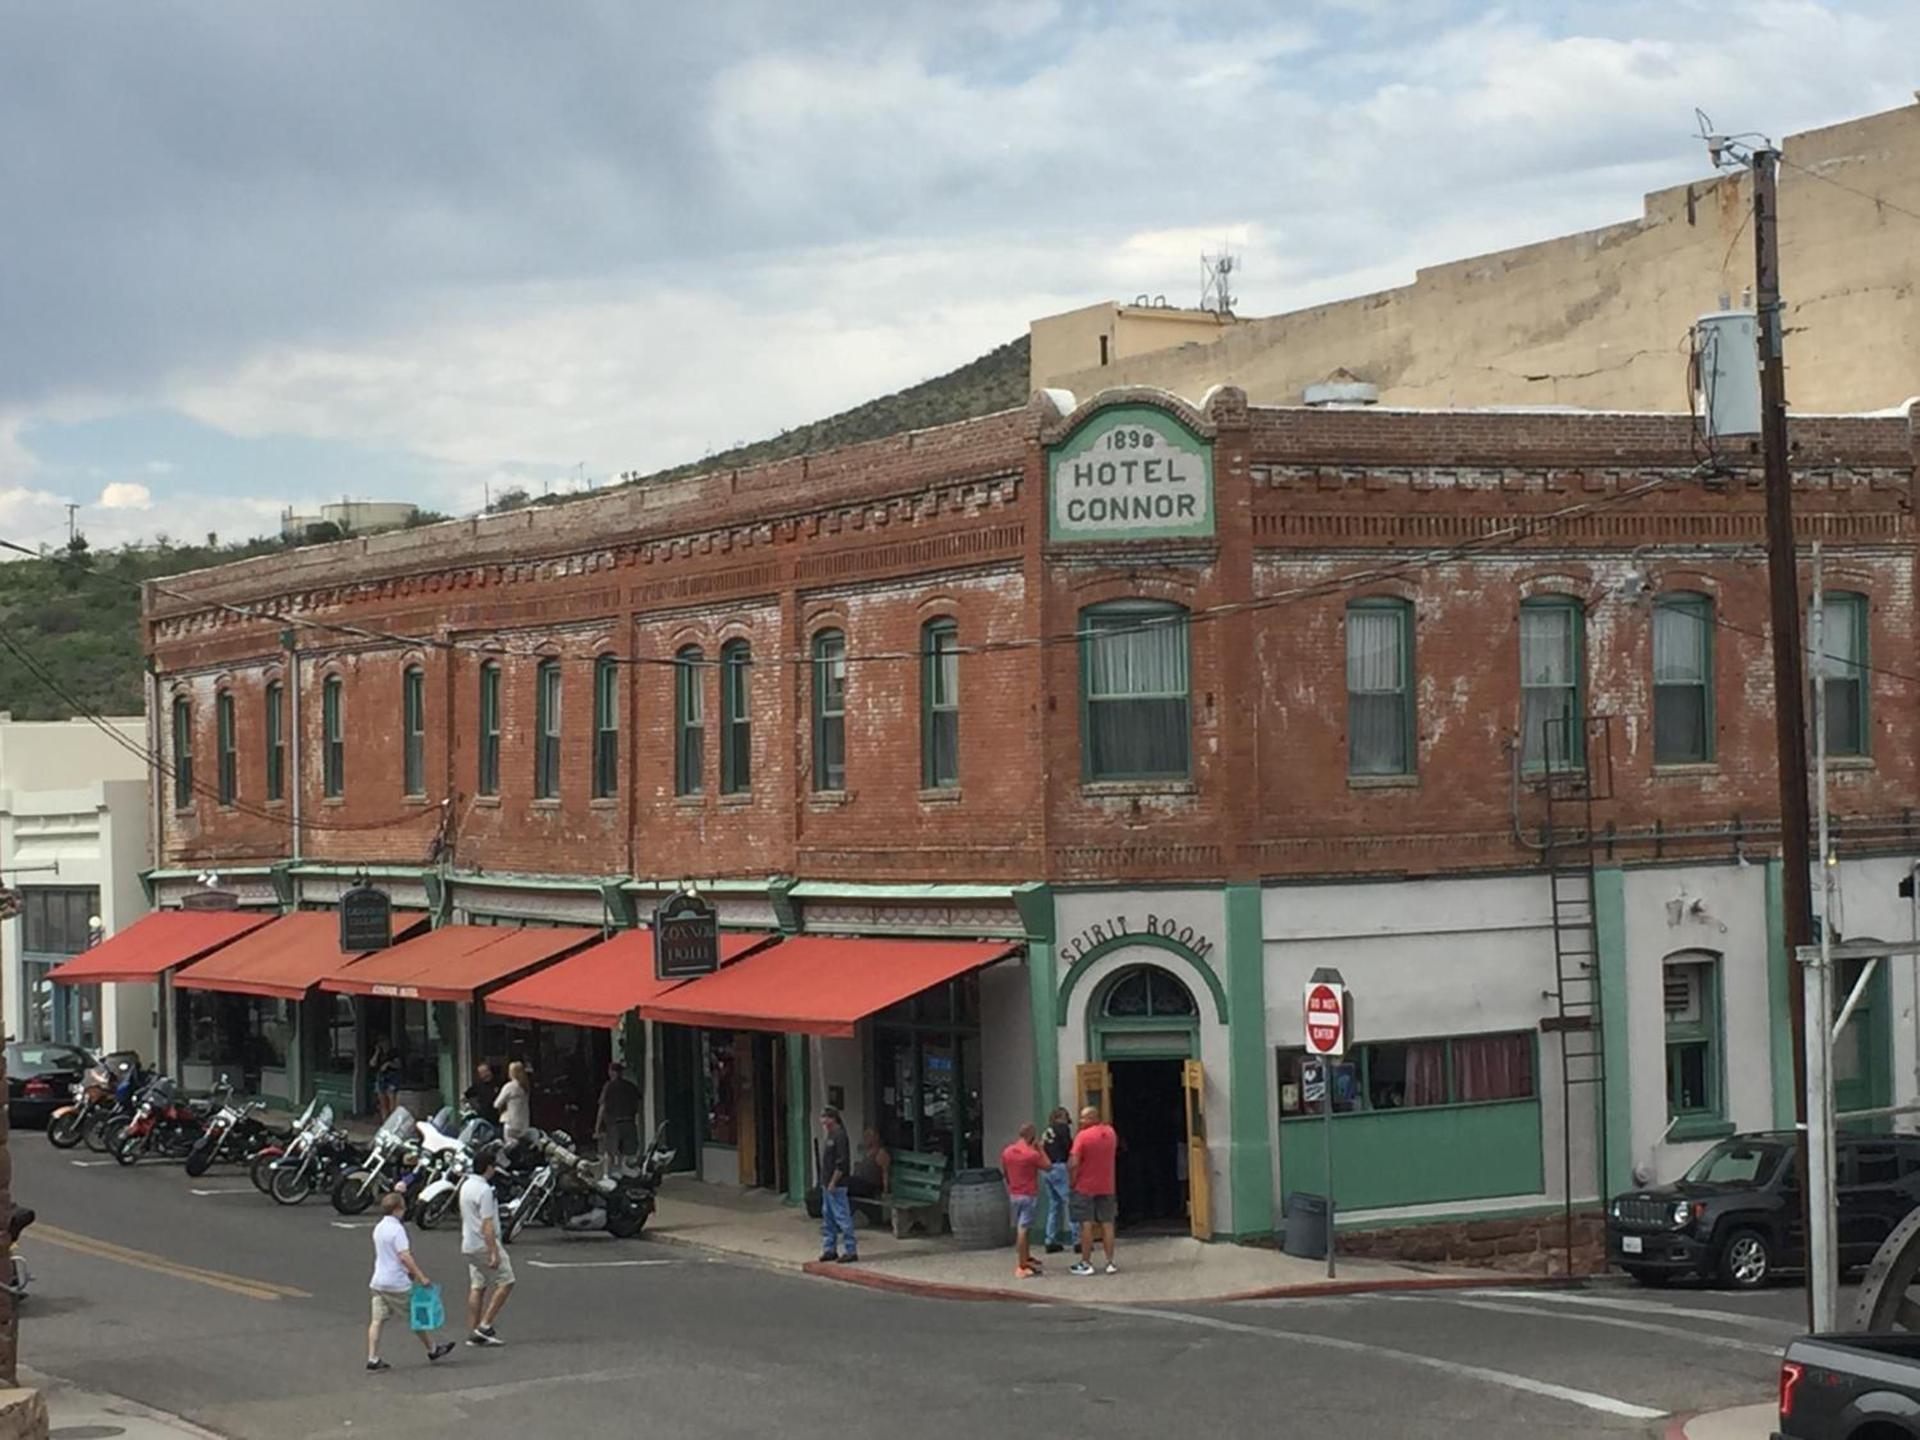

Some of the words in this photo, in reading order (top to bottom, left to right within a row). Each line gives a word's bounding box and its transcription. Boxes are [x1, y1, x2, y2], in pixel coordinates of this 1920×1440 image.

[1107, 430, 1154, 450] 1898
[1074, 458, 1186, 487] HOTEL
[1067, 494, 1195, 522] CONNOR
[1060, 915, 1127, 965] SPIRIT
[1146, 914, 1213, 958] ROOM
[1313, 1027, 1335, 1040] ENTER
